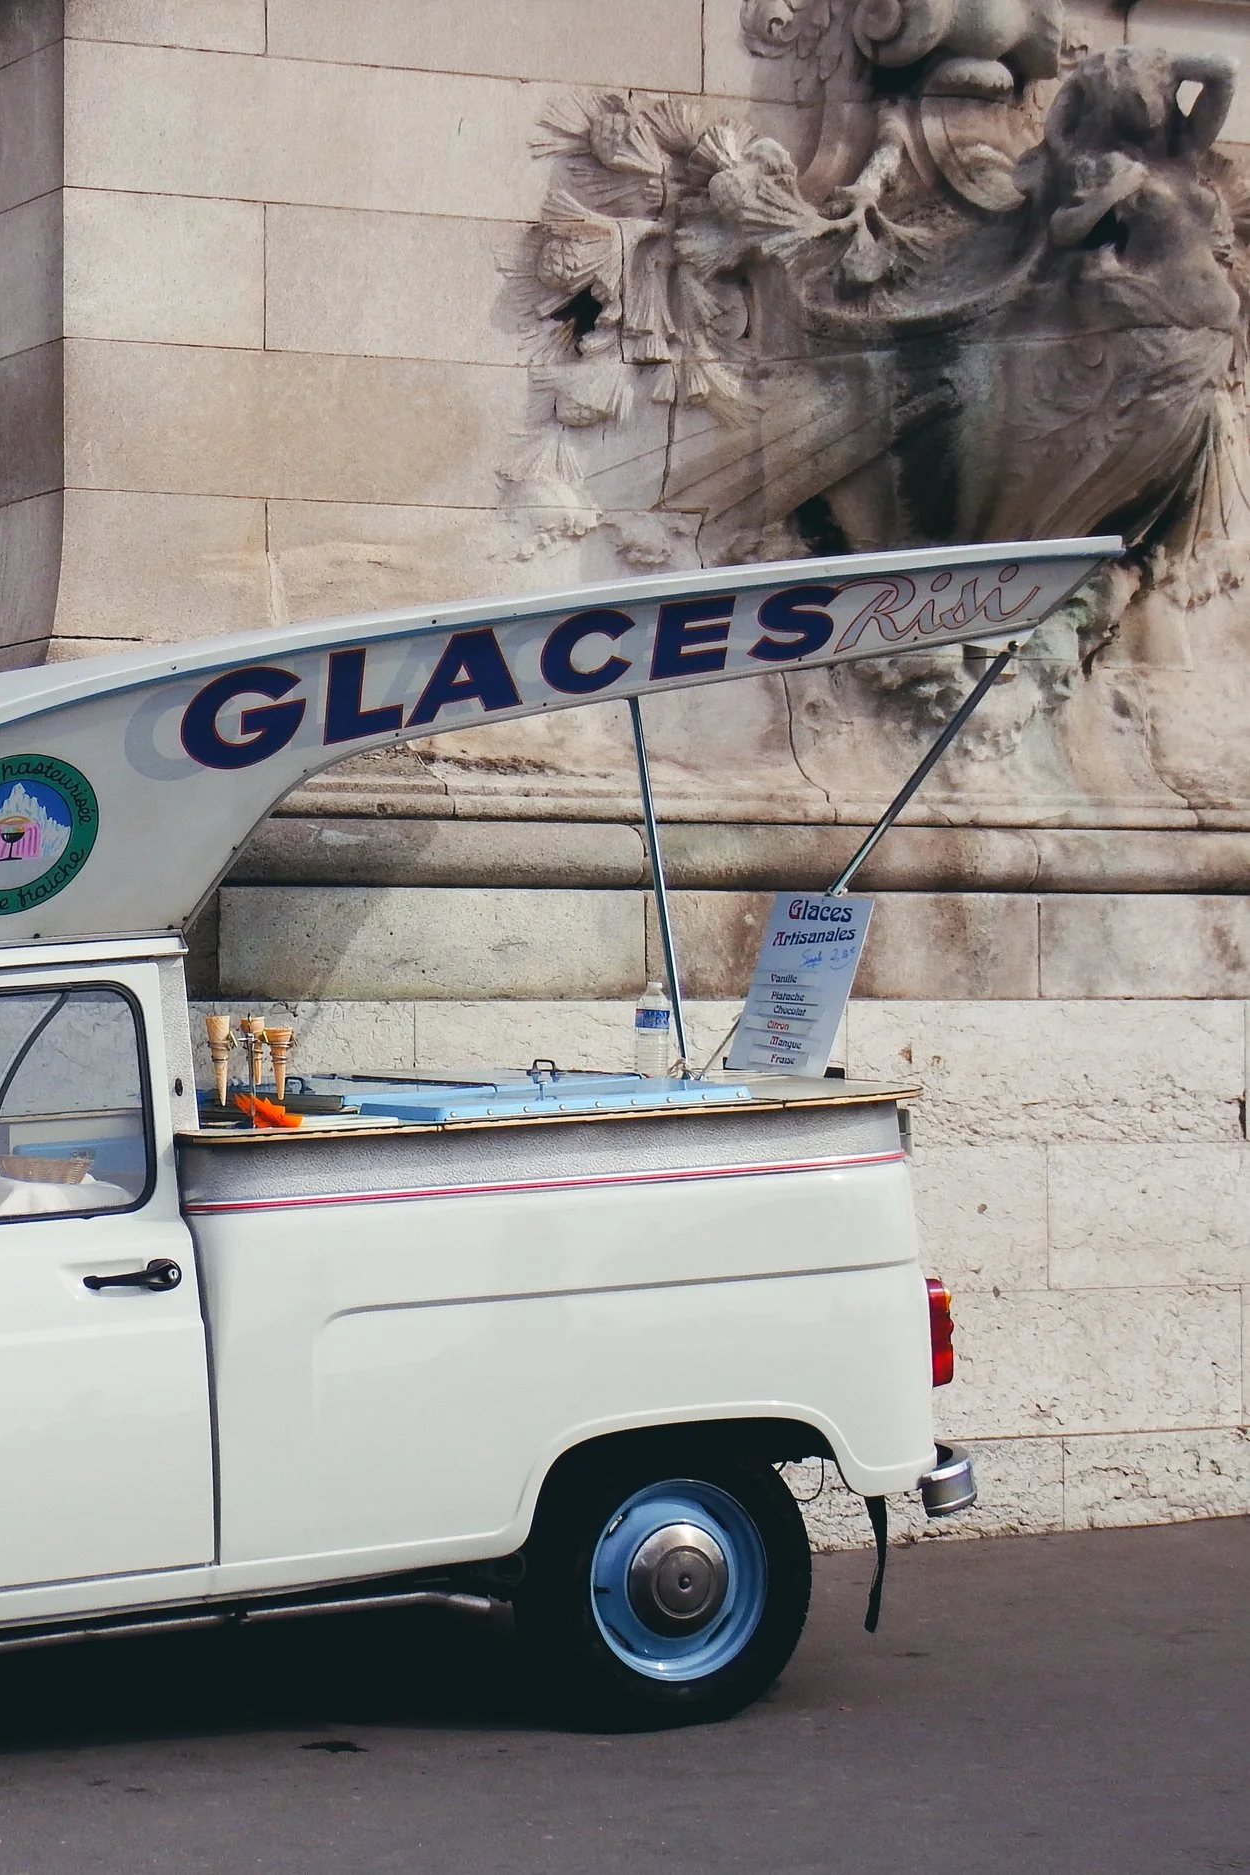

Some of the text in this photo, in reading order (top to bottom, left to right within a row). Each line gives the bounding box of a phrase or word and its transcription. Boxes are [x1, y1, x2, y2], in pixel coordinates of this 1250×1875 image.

[180, 585, 843, 770] GLACES
[1, 761, 96, 826] pasteurisée
[788, 899, 854, 923] Glaces
[772, 927, 857, 947] Artisanales
[771, 973, 798, 984] Vanille
[771, 990, 806, 1002] Pistache
[773, 1005, 807, 1017] Chocolat
[766, 1020, 791, 1032] Citron
[770, 1035, 803, 1050] Mangue
[770, 1053, 797, 1065] Fraise
